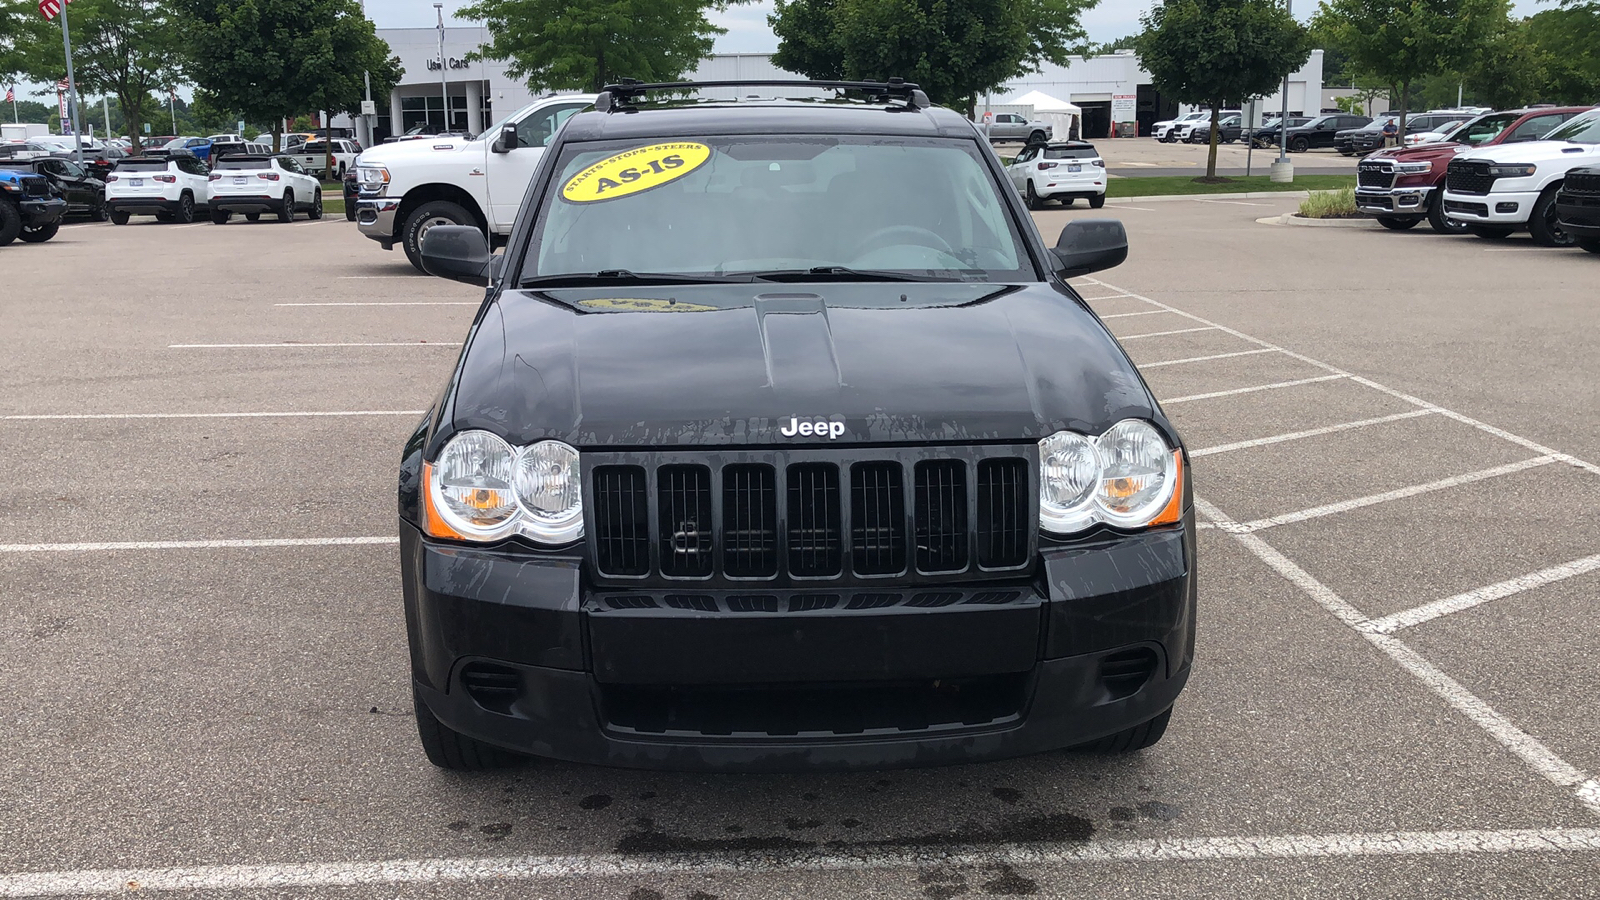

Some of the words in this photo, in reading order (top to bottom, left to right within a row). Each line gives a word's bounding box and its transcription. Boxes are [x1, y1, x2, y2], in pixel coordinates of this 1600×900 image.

[449, 57, 470, 70] Cars
[595, 154, 686, 195] AS-IS
[780, 417, 846, 440] Jeep
